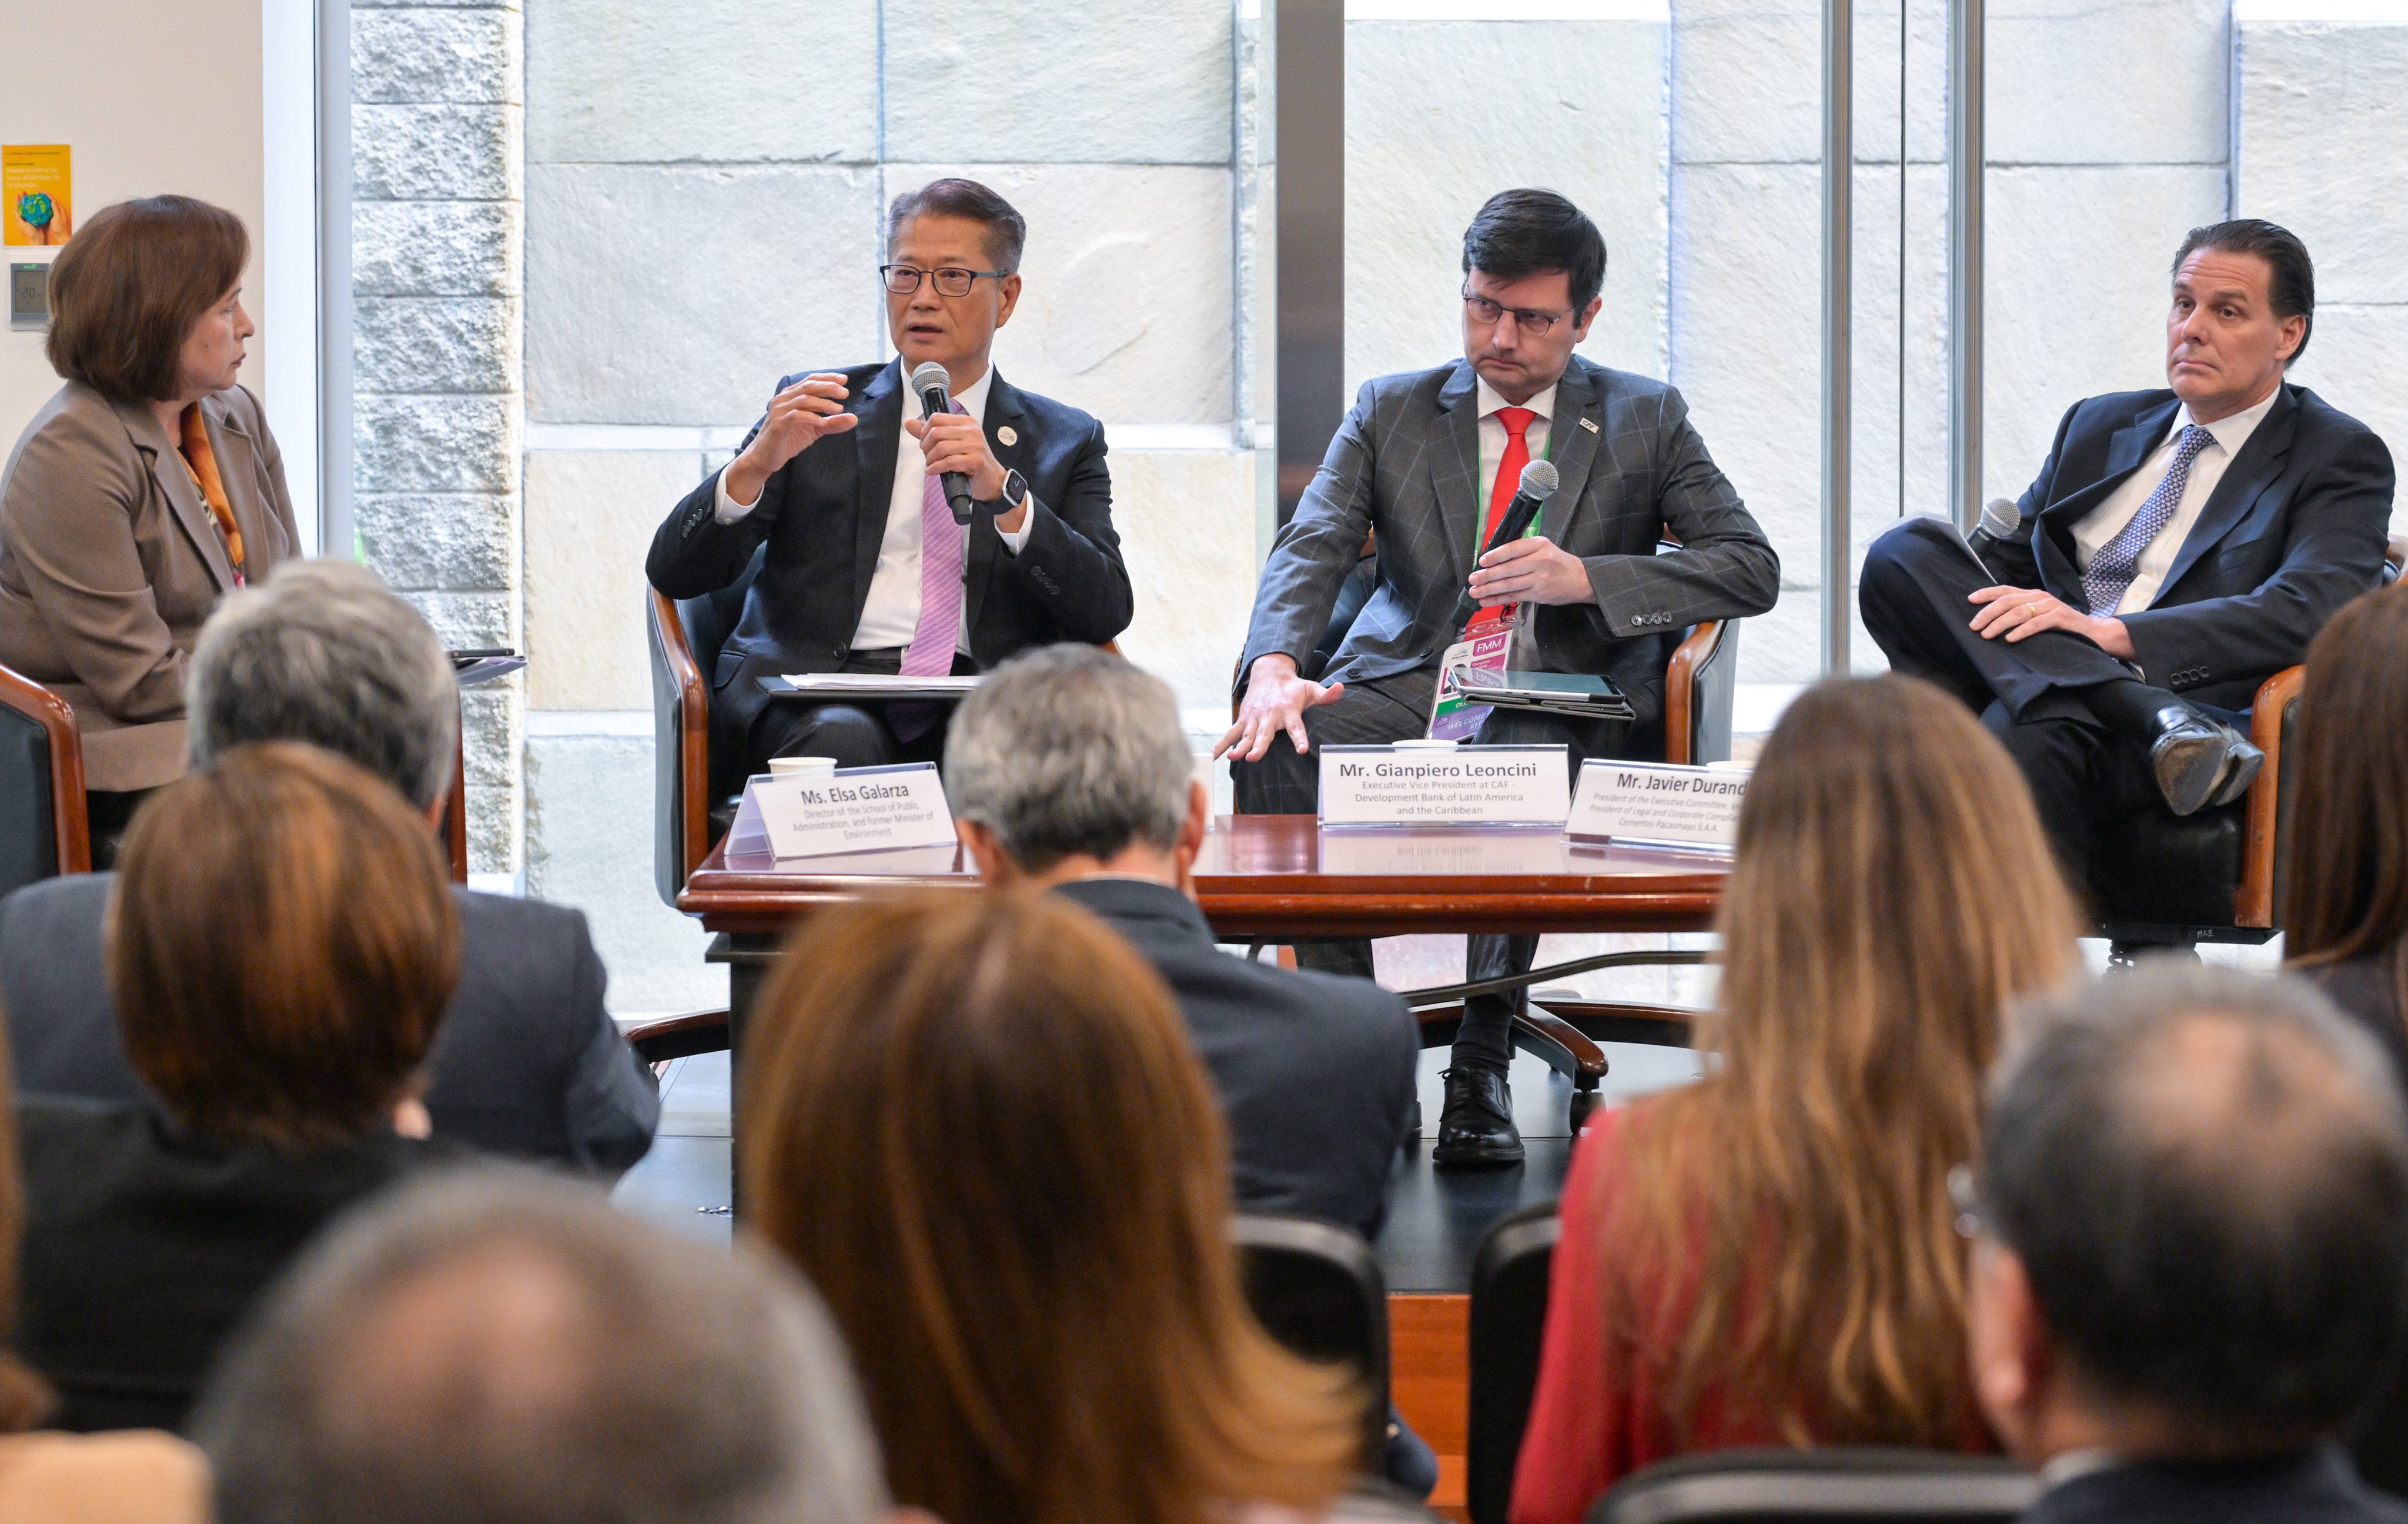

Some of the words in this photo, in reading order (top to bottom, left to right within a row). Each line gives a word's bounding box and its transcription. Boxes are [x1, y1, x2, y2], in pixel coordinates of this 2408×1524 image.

[1477, 639, 1502, 653] FMM
[1448, 713, 1486, 730] WELCOME
[1470, 720, 1483, 730] KIT
[1340, 764, 1369, 777] Mr.
[1376, 763, 1460, 780] Gianpiero
[1466, 763, 1537, 777] Leoncini
[1362, 781, 1407, 790] Executive
[1409, 781, 1429, 790] Vice
[1432, 781, 1476, 790] President
[1491, 781, 1510, 790] CAF
[1617, 773, 1641, 789] Mr.
[1646, 776, 1689, 792] Javier
[801, 790, 827, 805] Ms.
[829, 787, 857, 803] Elsa
[859, 784, 909, 800] Galarza
[1355, 793, 1419, 803] Development
[1422, 793, 1444, 801] Bank
[1447, 793, 1456, 801] of
[1459, 793, 1482, 801] Latin
[1484, 793, 1523, 802] America
[1593, 793, 1627, 803] President
[1628, 795, 1637, 804] of
[1638, 796, 1649, 804] the
[1651, 797, 1685, 807] Executive
[1686, 799, 1728, 810] Committee,
[804, 807, 835, 819] Director
[837, 807, 845, 816] of
[848, 806, 860, 815] the
[862, 803, 885, 813] School
[888, 802, 896, 811] of
[897, 801, 919, 810] Public
[1397, 806, 1414, 814] and
[1417, 806, 1433, 814] the
[1435, 806, 1483, 814] Caribbean
[1589, 804, 1623, 814] President
[1623, 806, 1632, 814] of
[1633, 807, 1651, 818] Legal
[1653, 808, 1667, 817] and
[1668, 810, 1704, 821] Corporate
[793, 819, 851, 832] Administration,
[853, 817, 867, 827] and
[867, 815, 893, 826] former
[895, 813, 924, 823] Minister
[926, 811, 934, 821] of
[1619, 817, 1654, 827] Cementos
[1656, 820, 1697, 832] Pacasmayo
[1698, 823, 1718, 833] S.A.A.
[844, 827, 892, 840] Environment
